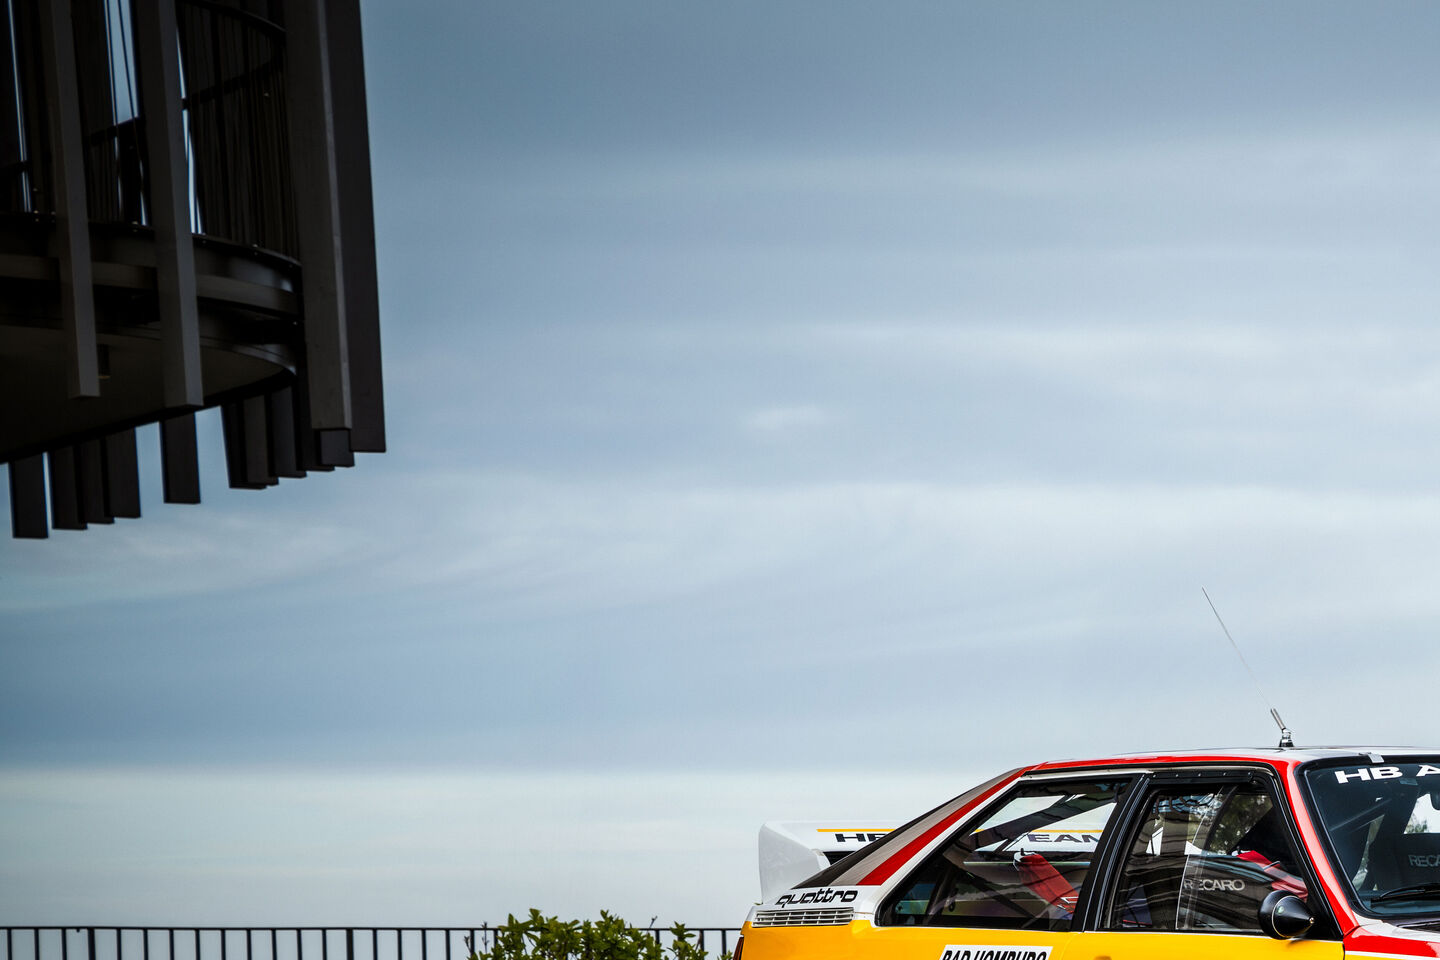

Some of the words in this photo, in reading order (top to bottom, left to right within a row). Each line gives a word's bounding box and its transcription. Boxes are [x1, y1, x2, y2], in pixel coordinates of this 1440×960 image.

[1335, 766, 1403, 784] HB
[1184, 878, 1246, 891] RECARO
[774, 887, 858, 909] quattro
